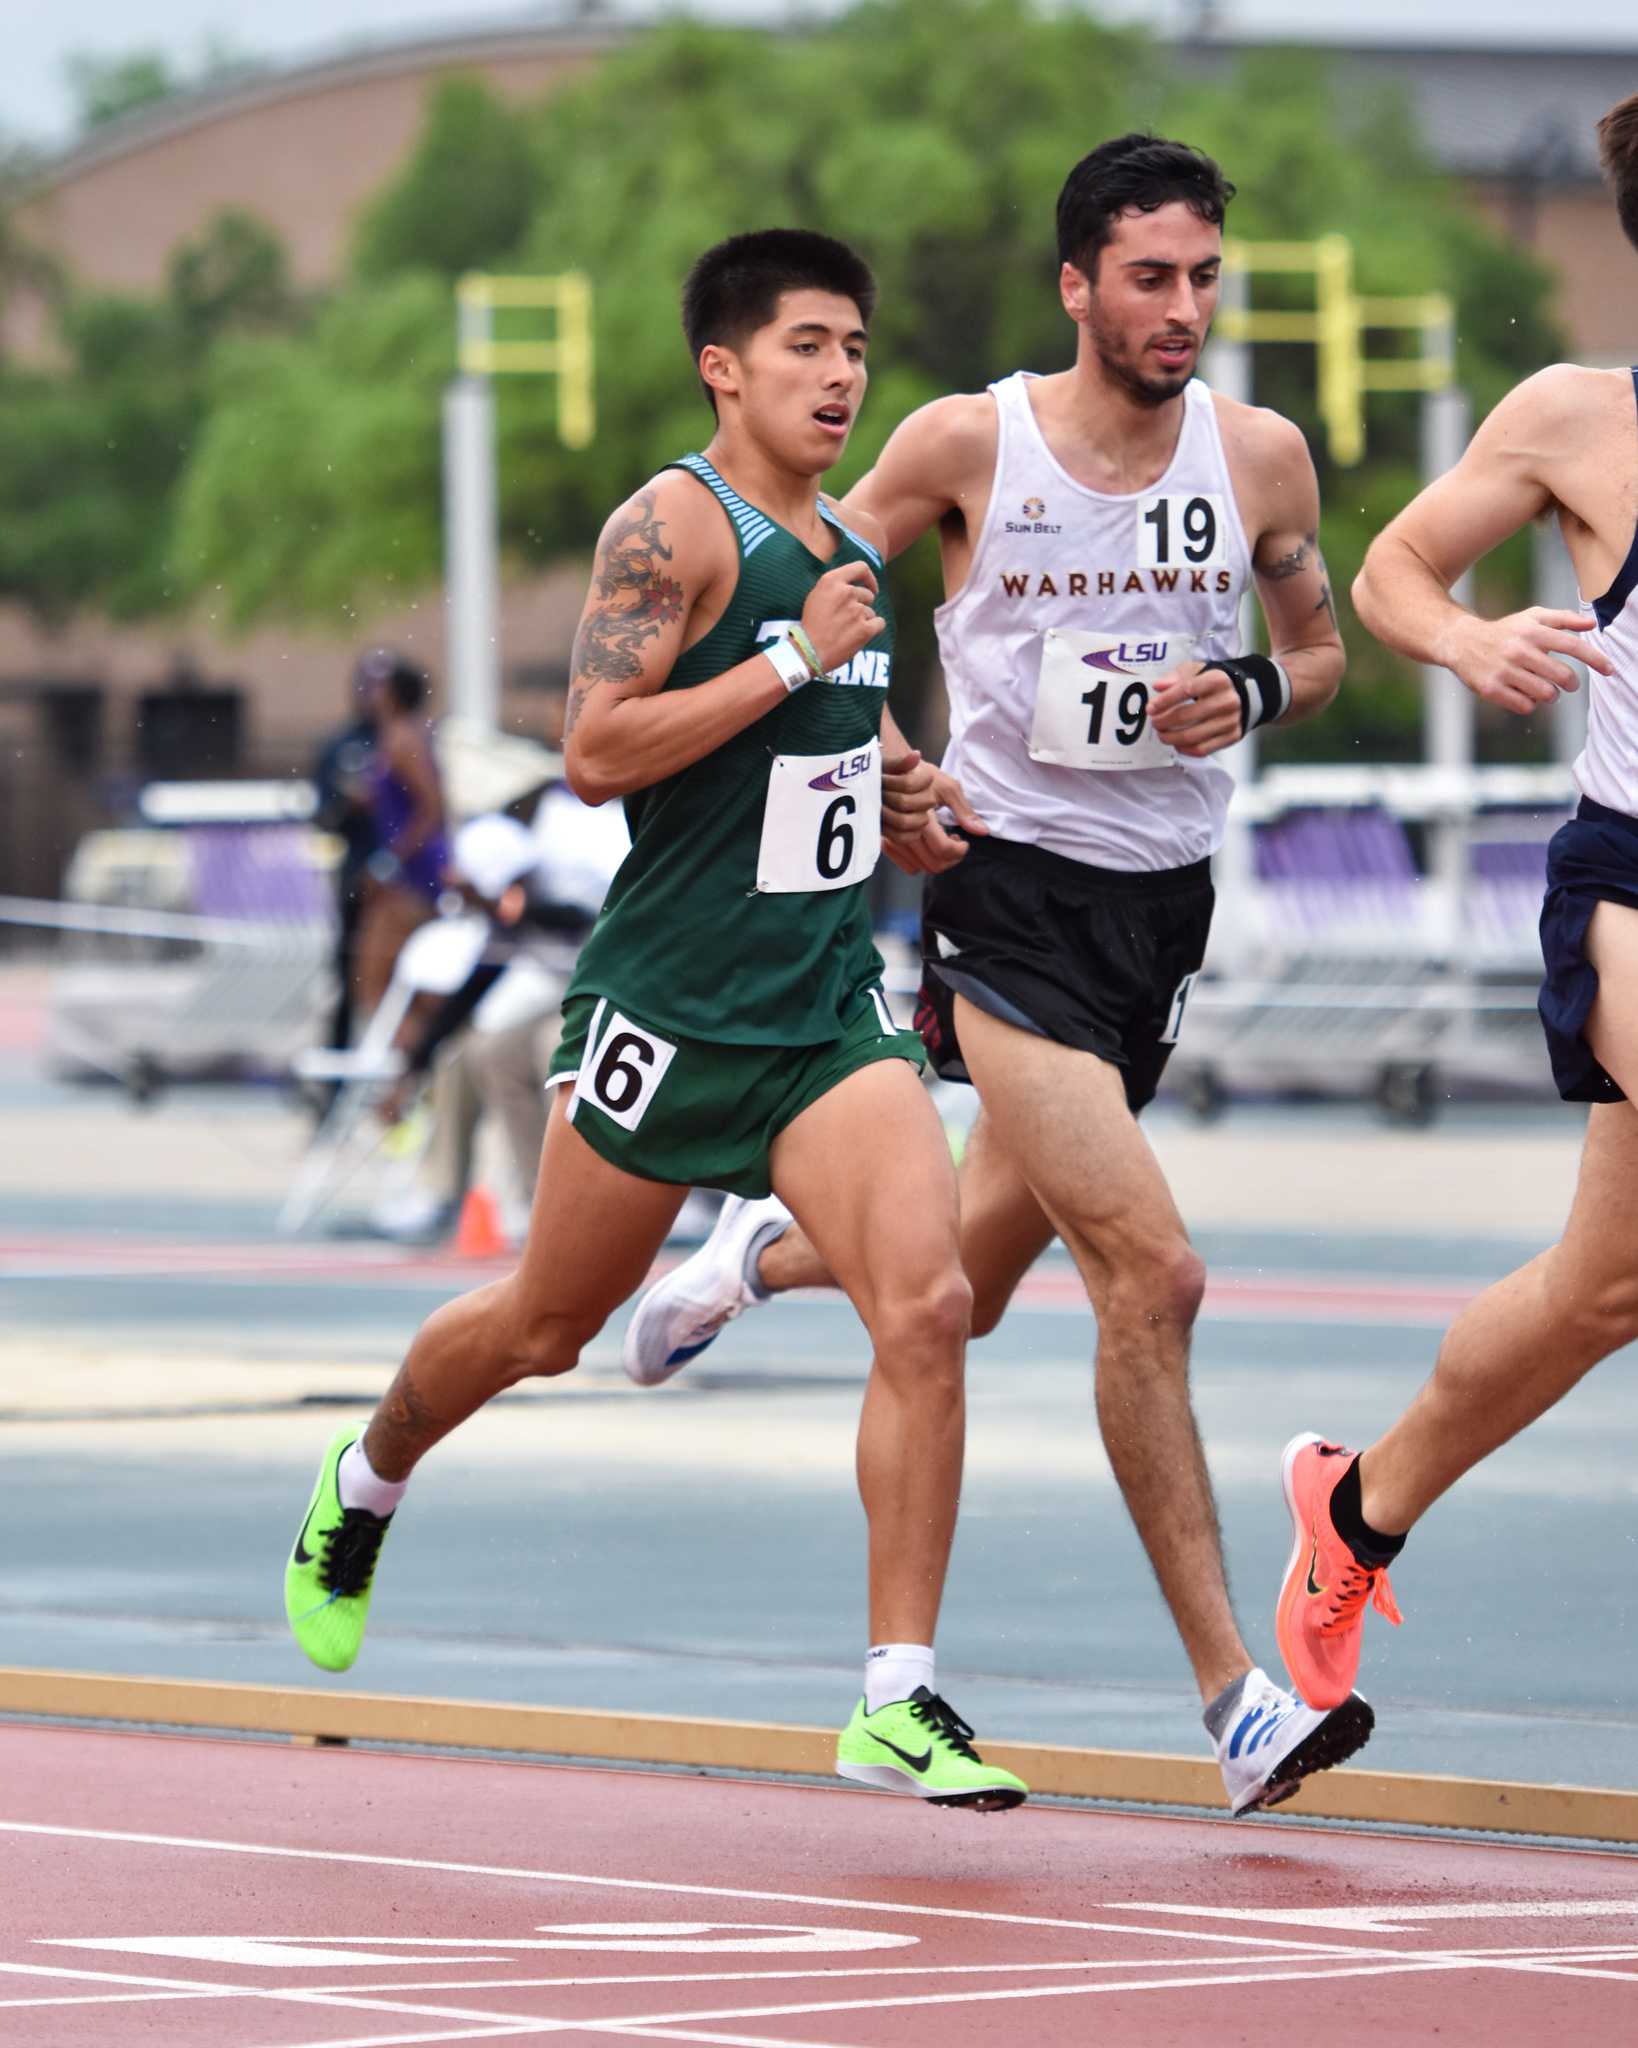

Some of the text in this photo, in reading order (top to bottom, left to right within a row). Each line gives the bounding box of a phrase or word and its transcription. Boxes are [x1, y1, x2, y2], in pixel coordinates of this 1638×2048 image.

[1145, 497, 1216, 564] 19
[1001, 568, 1232, 598] WARHAWKS
[1118, 642, 1167, 662] LSU
[1081, 681, 1149, 746] 19
[838, 751, 871, 779] LSU
[816, 794, 856, 880] 6
[594, 1032, 655, 1113] 6
